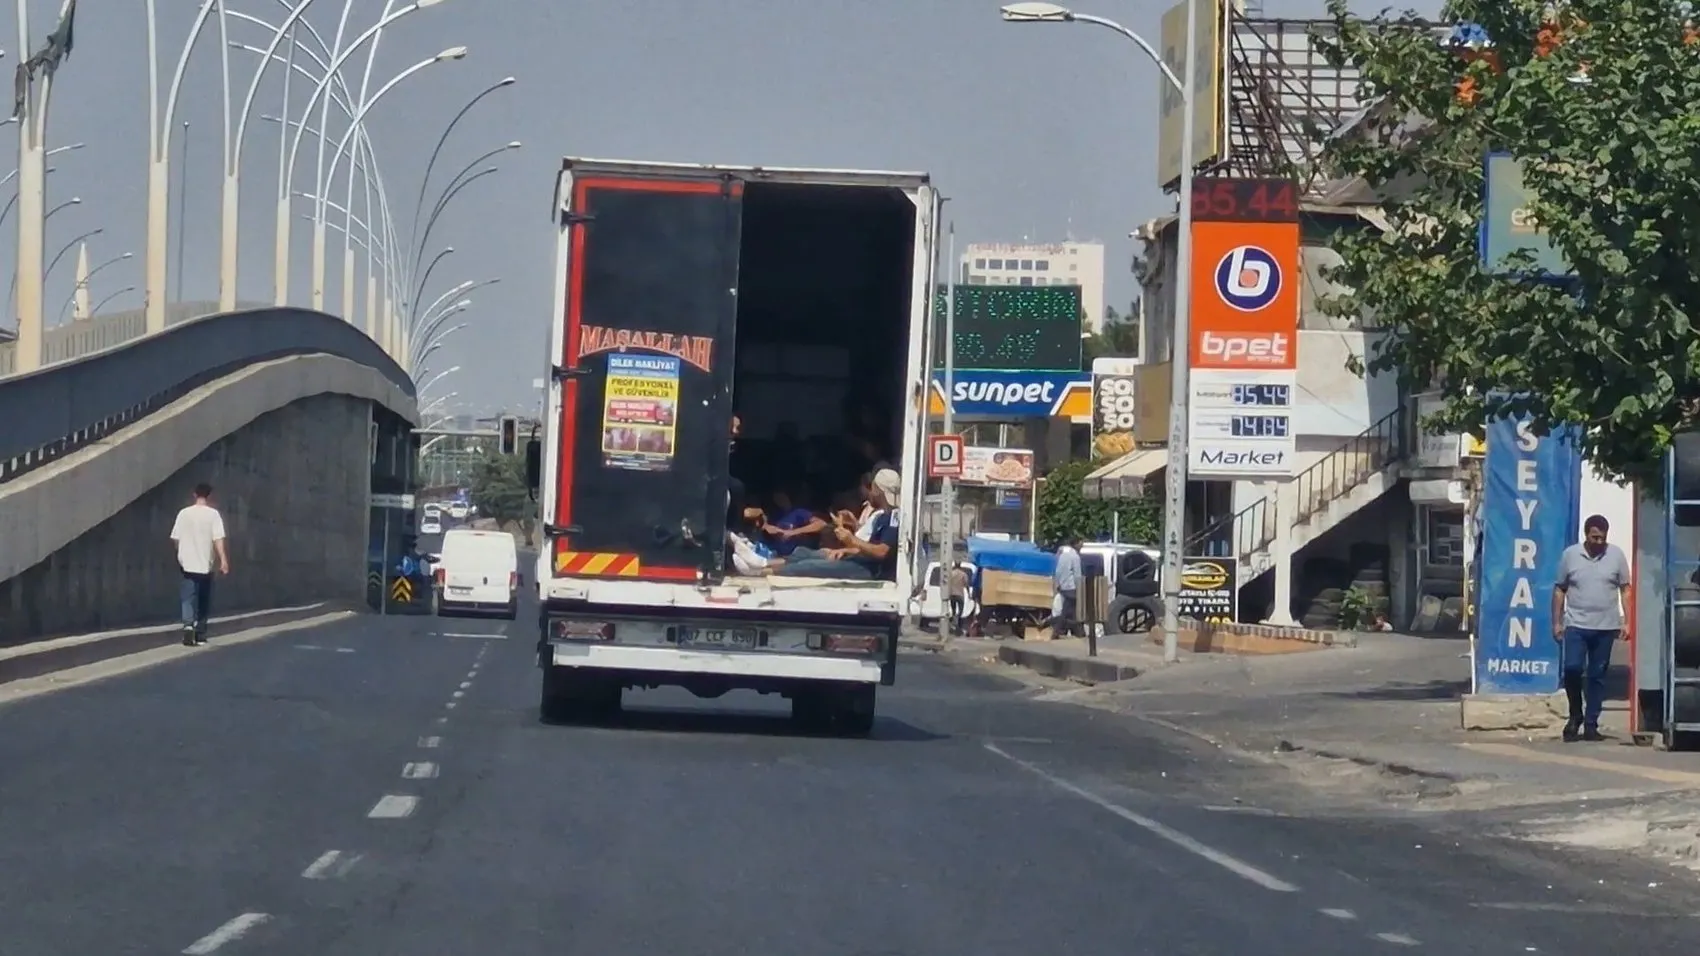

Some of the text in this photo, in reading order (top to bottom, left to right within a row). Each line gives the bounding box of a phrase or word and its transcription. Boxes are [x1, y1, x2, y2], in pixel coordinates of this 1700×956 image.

[578, 324, 713, 372] MAŞALLAH
[1202, 331, 1288, 361] bpet
[953, 380, 1055, 405] sunpet
[940, 444, 953, 461] D
[1200, 450, 1284, 464] Market
[1508, 420, 1538, 648] SEYRAN
[1488, 658, 1550, 674] MARKET
